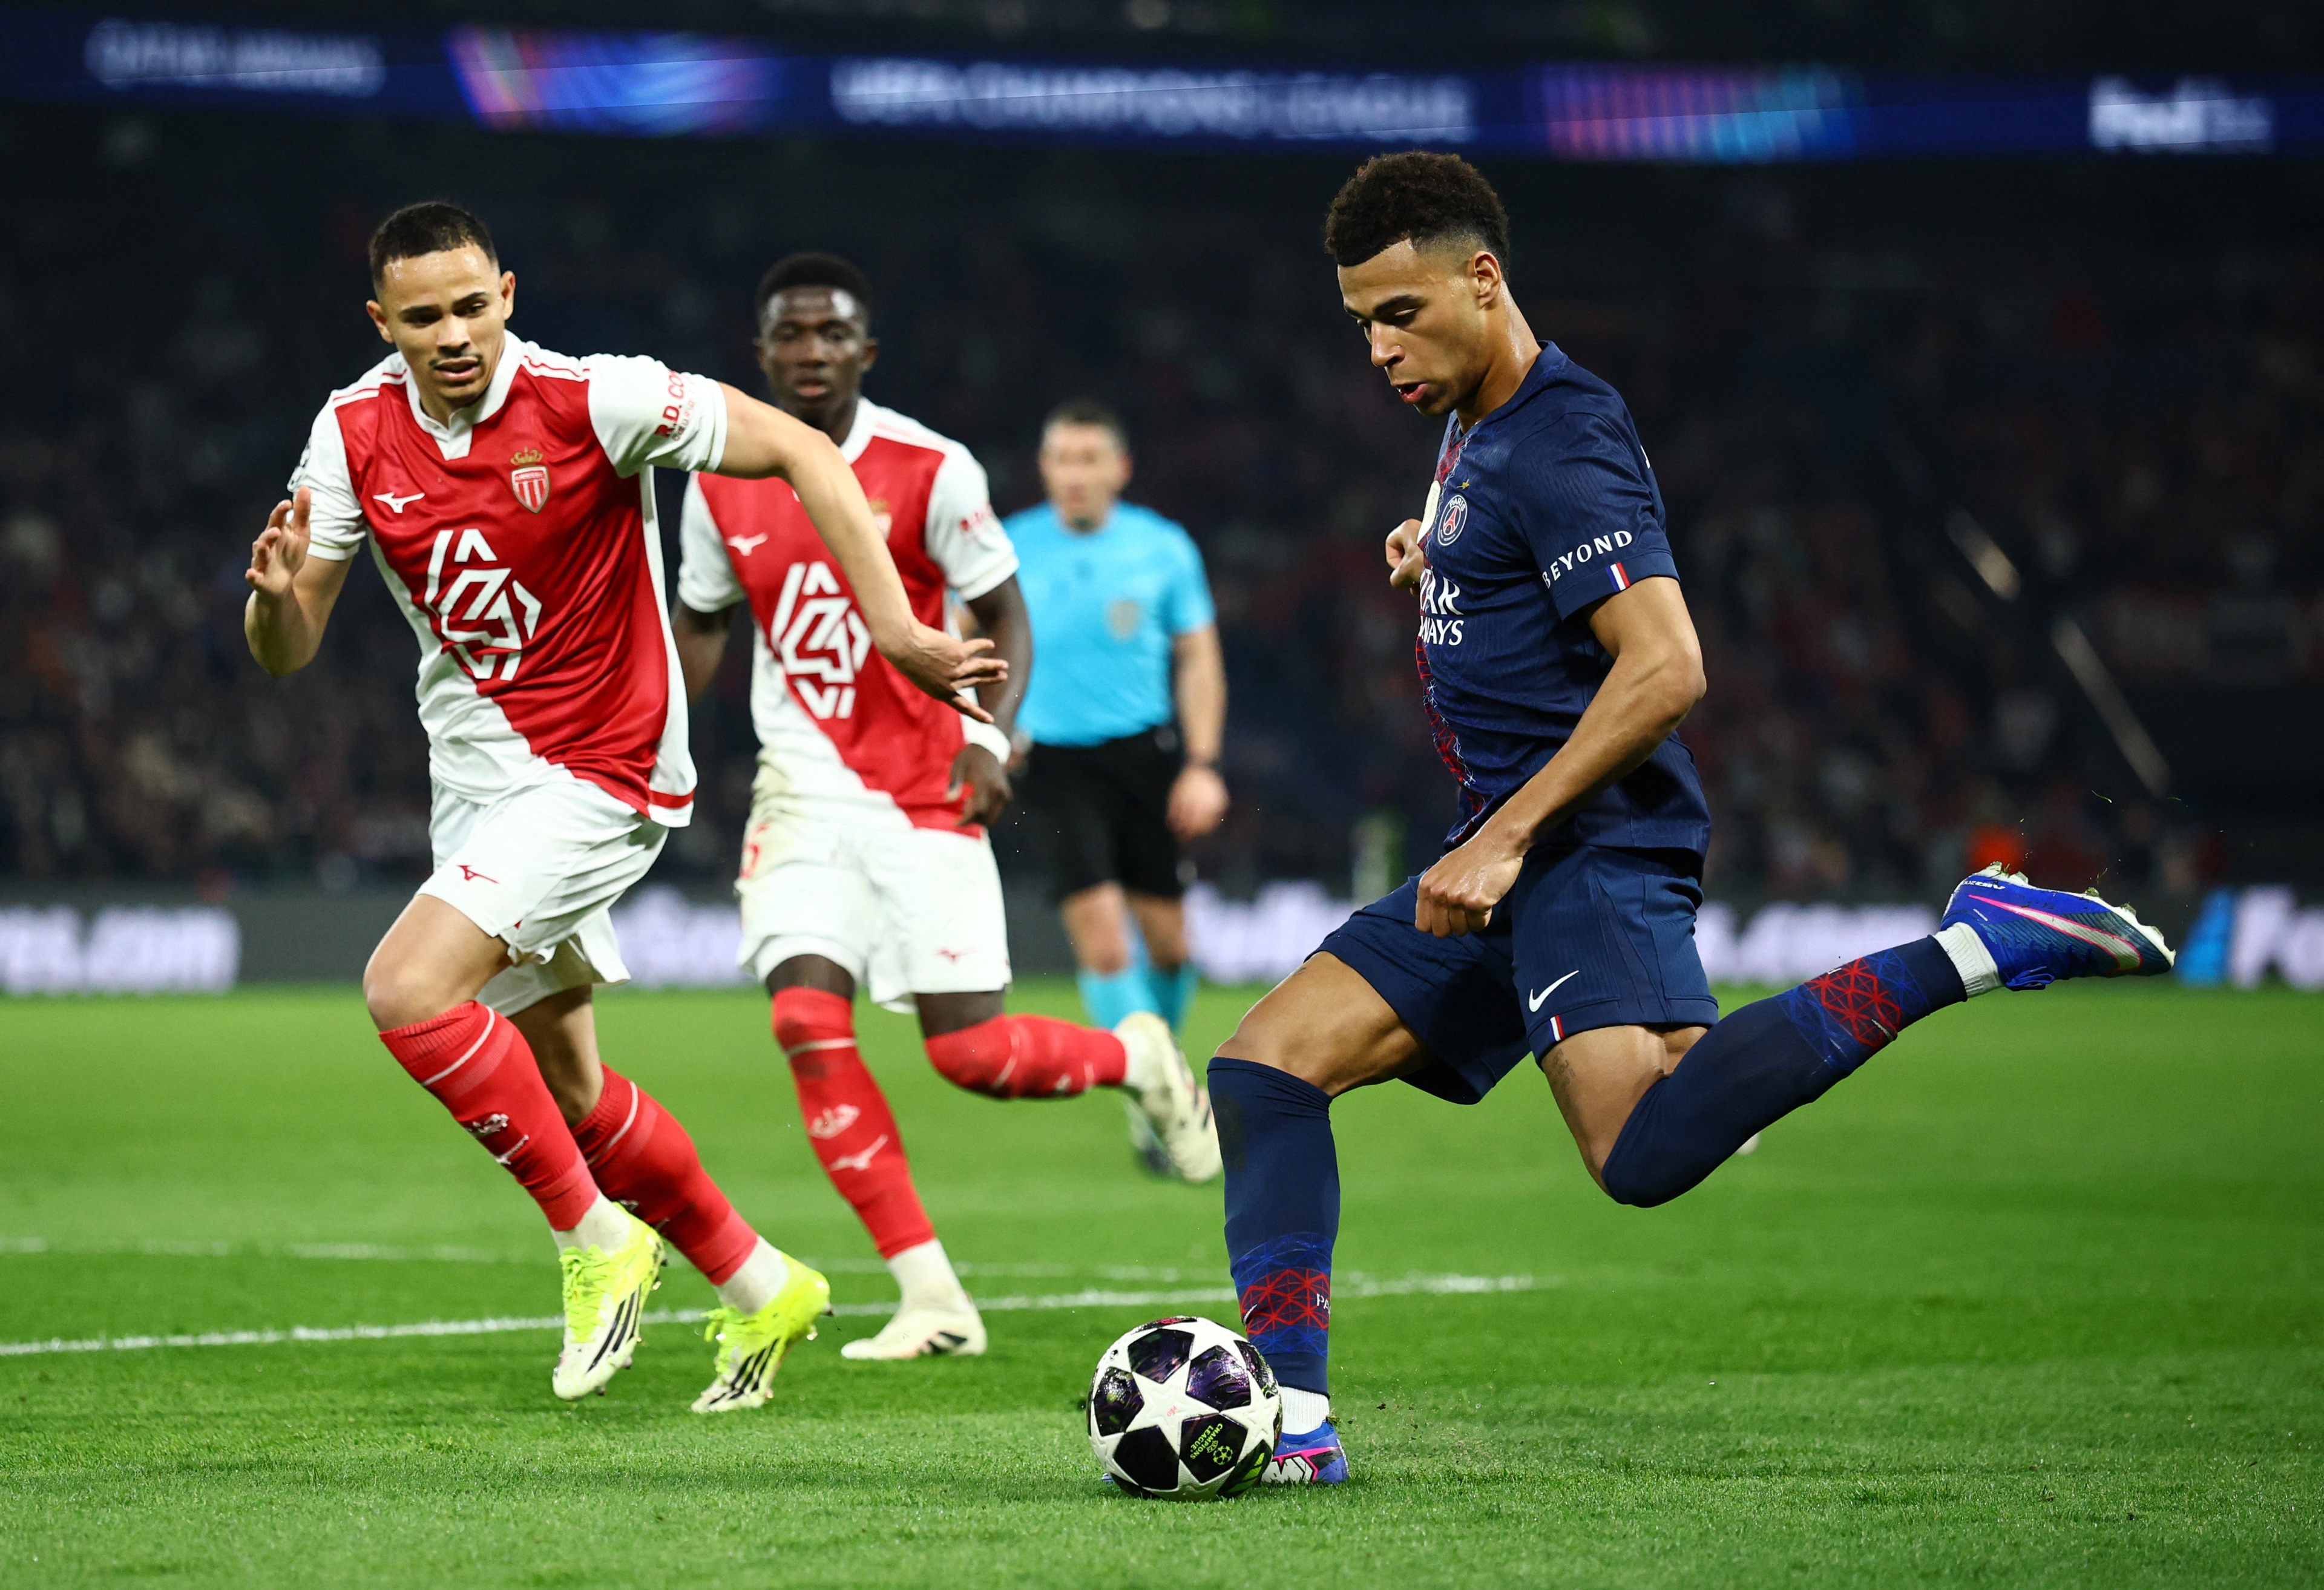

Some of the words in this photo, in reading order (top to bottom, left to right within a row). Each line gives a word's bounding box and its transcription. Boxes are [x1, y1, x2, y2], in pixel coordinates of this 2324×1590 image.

[1449, 498, 1466, 512] PARIS
[1542, 531, 1632, 589] BEYOND
[1316, 1293, 1331, 1314] PA
[1190, 1425, 1214, 1450] LEAGUE
[1190, 1423, 1223, 1459] CHAMPIONS
